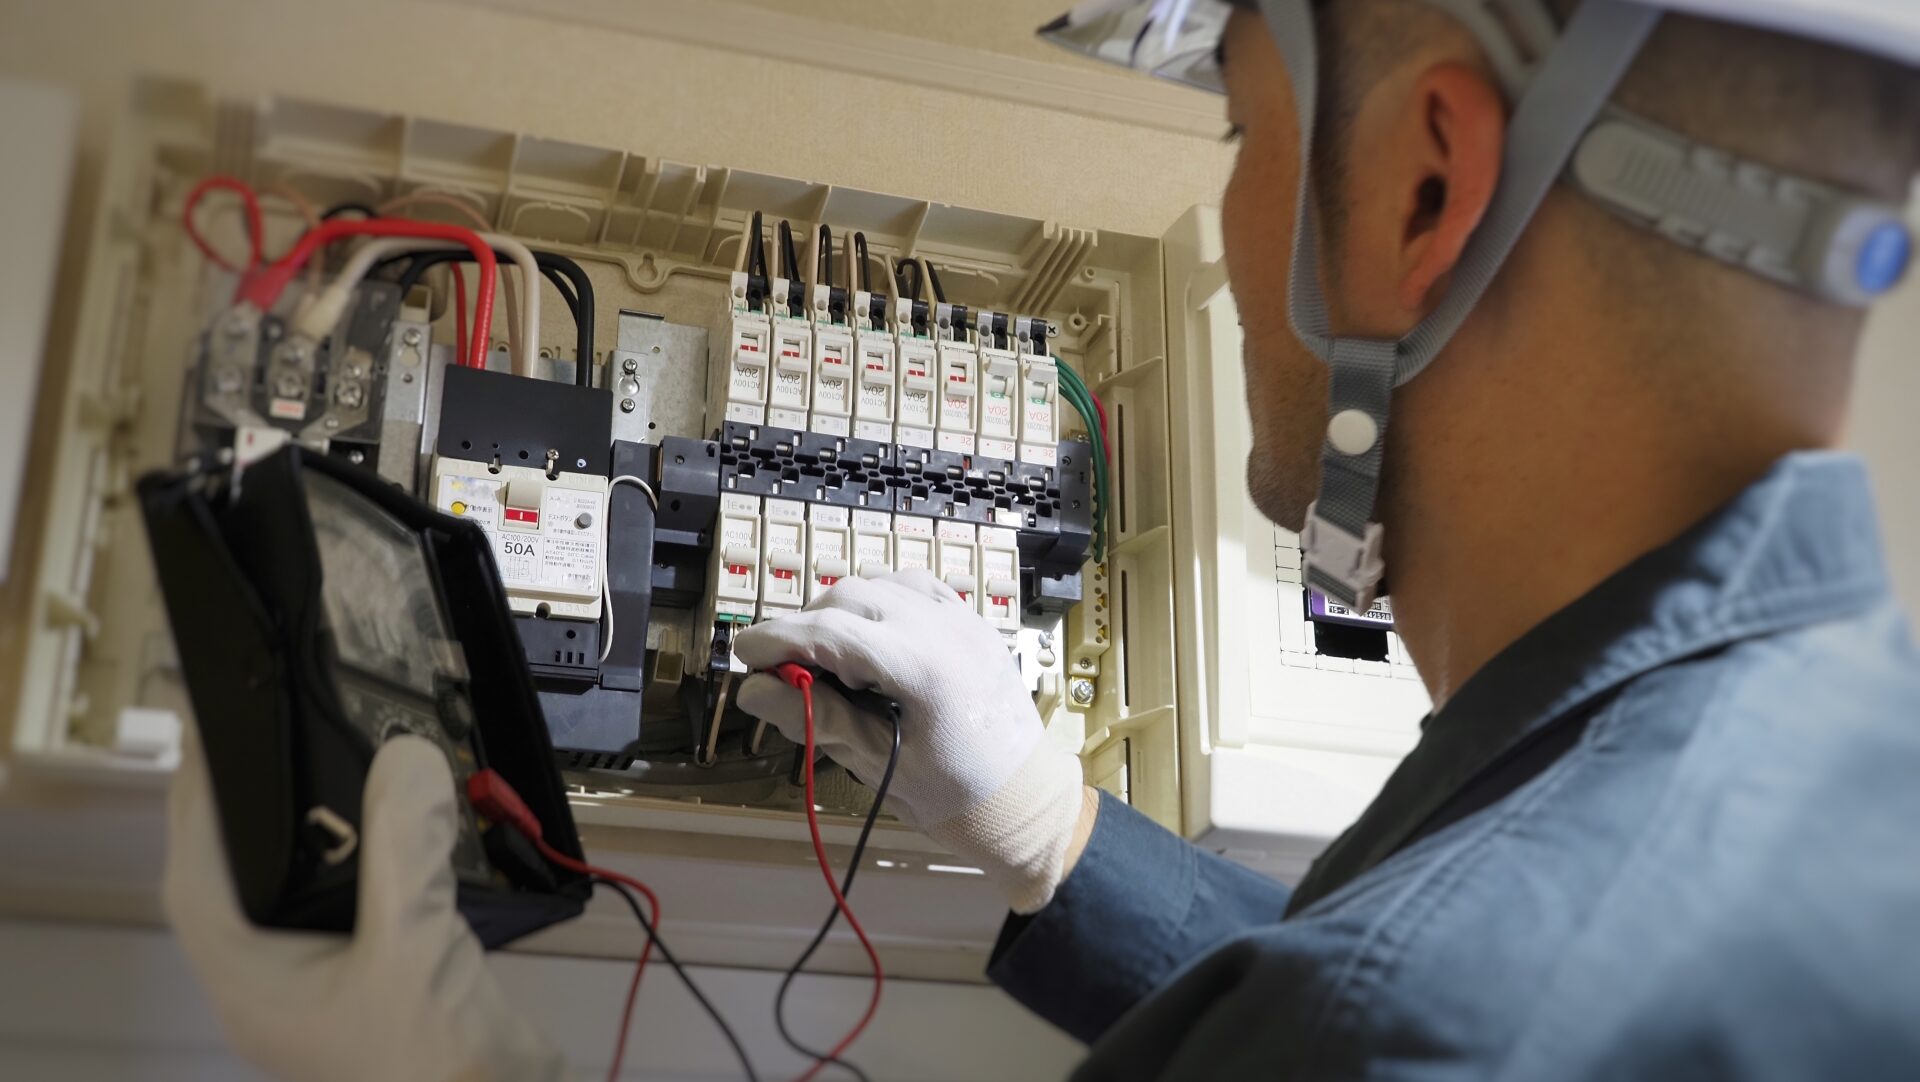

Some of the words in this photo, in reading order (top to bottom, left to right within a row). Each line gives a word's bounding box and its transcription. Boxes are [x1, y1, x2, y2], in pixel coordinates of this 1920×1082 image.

[988, 405, 1008, 416] 20A
[1028, 410, 1049, 422] 20A
[502, 534, 539, 544] AC100/200V
[504, 542, 535, 556] 50A
